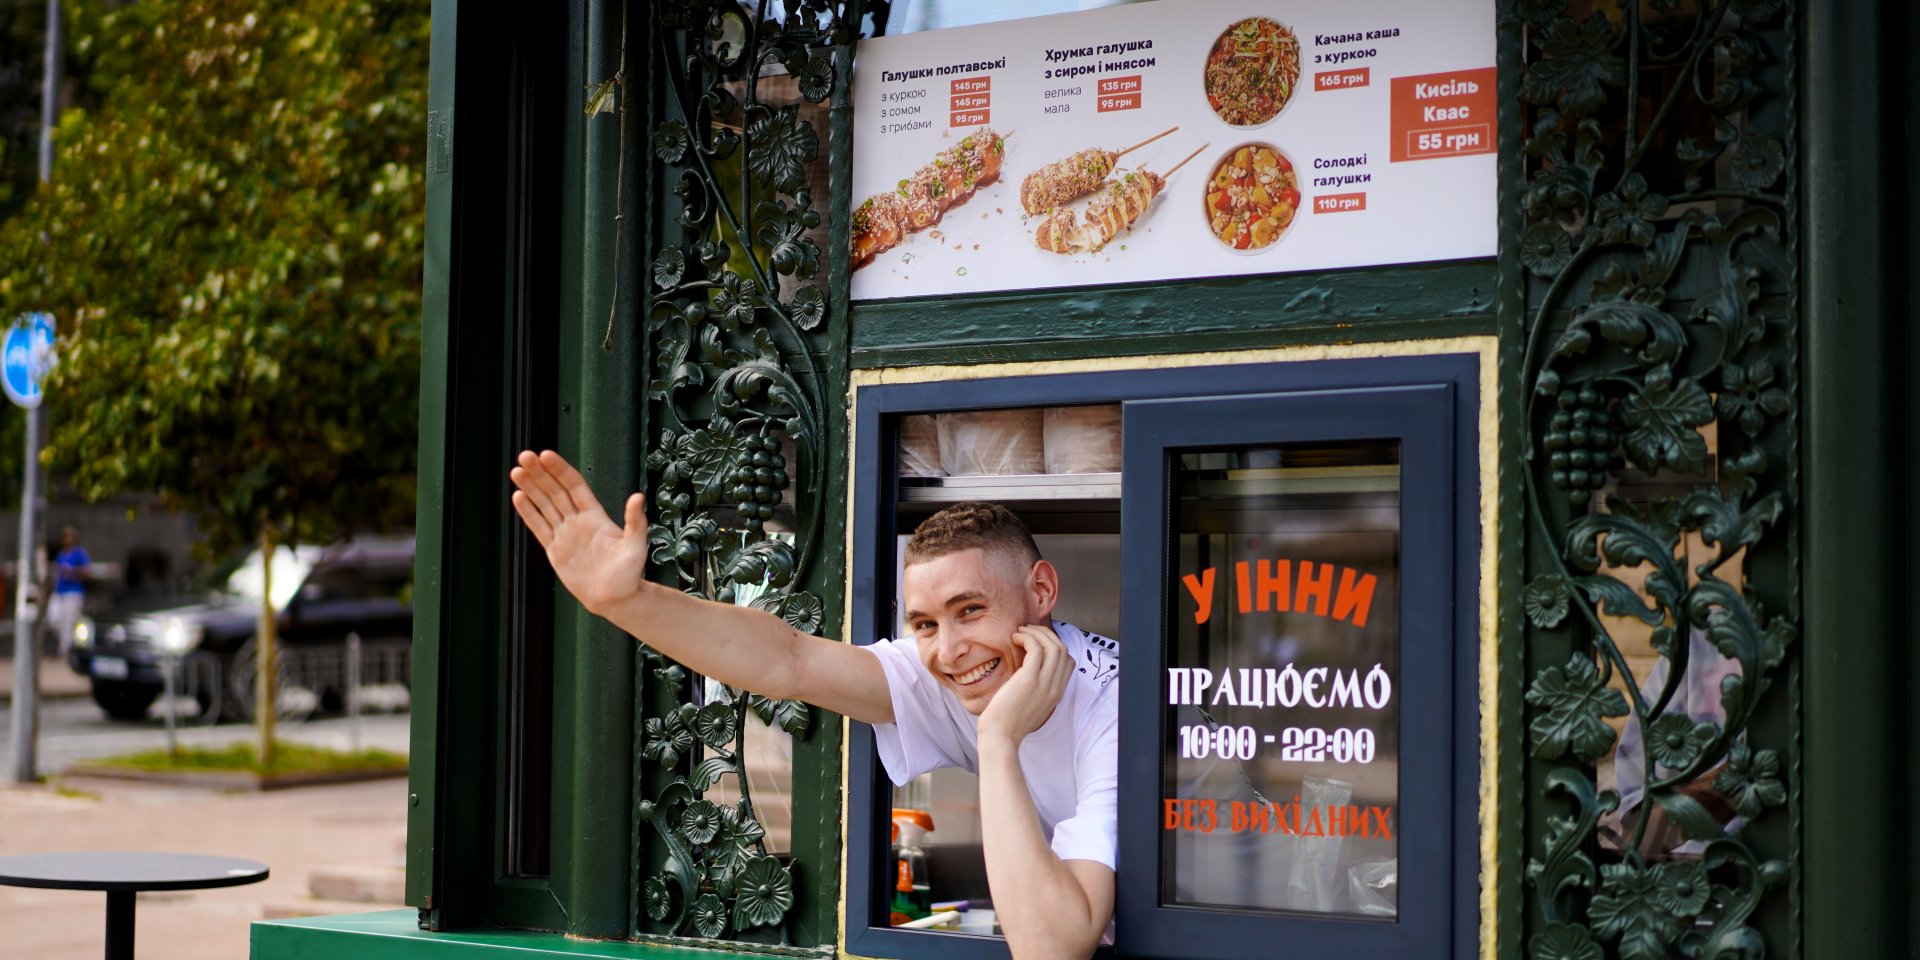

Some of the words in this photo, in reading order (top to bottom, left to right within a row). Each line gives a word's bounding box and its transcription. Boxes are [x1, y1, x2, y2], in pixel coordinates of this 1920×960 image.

[1315, 30, 1363, 46] Качана
[1366, 27, 1400, 40] каша
[1045, 45, 1093, 62] Хрумка
[1097, 38, 1153, 56] галушка
[1314, 54, 1321, 64] з
[1325, 48, 1376, 63] куркою
[882, 68, 933, 82] Галушки
[936, 57, 1005, 76] полтавські
[1045, 69, 1052, 79] з
[1055, 63, 1095, 78] сиром
[1098, 61, 1102, 73] і
[1105, 56, 1155, 72] мнясом
[955, 81, 970, 91] 145
[972, 80, 986, 91] грн
[1102, 81, 1118, 91] 135
[1120, 79, 1137, 90] грн
[1320, 76, 1340, 86] 165
[1343, 74, 1363, 86] грн
[890, 89, 926, 102] куркою
[1044, 86, 1082, 99] велика
[1416, 80, 1479, 100] Кисіль
[955, 98, 970, 107] 145
[972, 97, 986, 107] грн
[1044, 104, 1070, 114] мала
[1102, 99, 1114, 108] 95
[1115, 97, 1132, 109] грн
[881, 110, 887, 118] з
[889, 105, 921, 117] сомом
[956, 115, 967, 124] 95
[968, 113, 983, 124] грн
[1424, 104, 1469, 122] Квас
[881, 125, 886, 133] з
[889, 119, 932, 135] грибами
[1418, 134, 1441, 150] 55
[1446, 132, 1479, 152] грн
[1314, 155, 1367, 170] Солодкі
[1314, 173, 1371, 187] галушки
[1318, 199, 1336, 209] 110
[1339, 197, 1359, 210] грн
[1182, 567, 1216, 625] У
[1235, 559, 1377, 628] ІННИ
[1180, 725, 1256, 760] 10:00
[1282, 727, 1375, 764] 22:00
[1165, 798, 1217, 833] БЕЗ
[1231, 794, 1392, 839] ВИХІДНИХ
